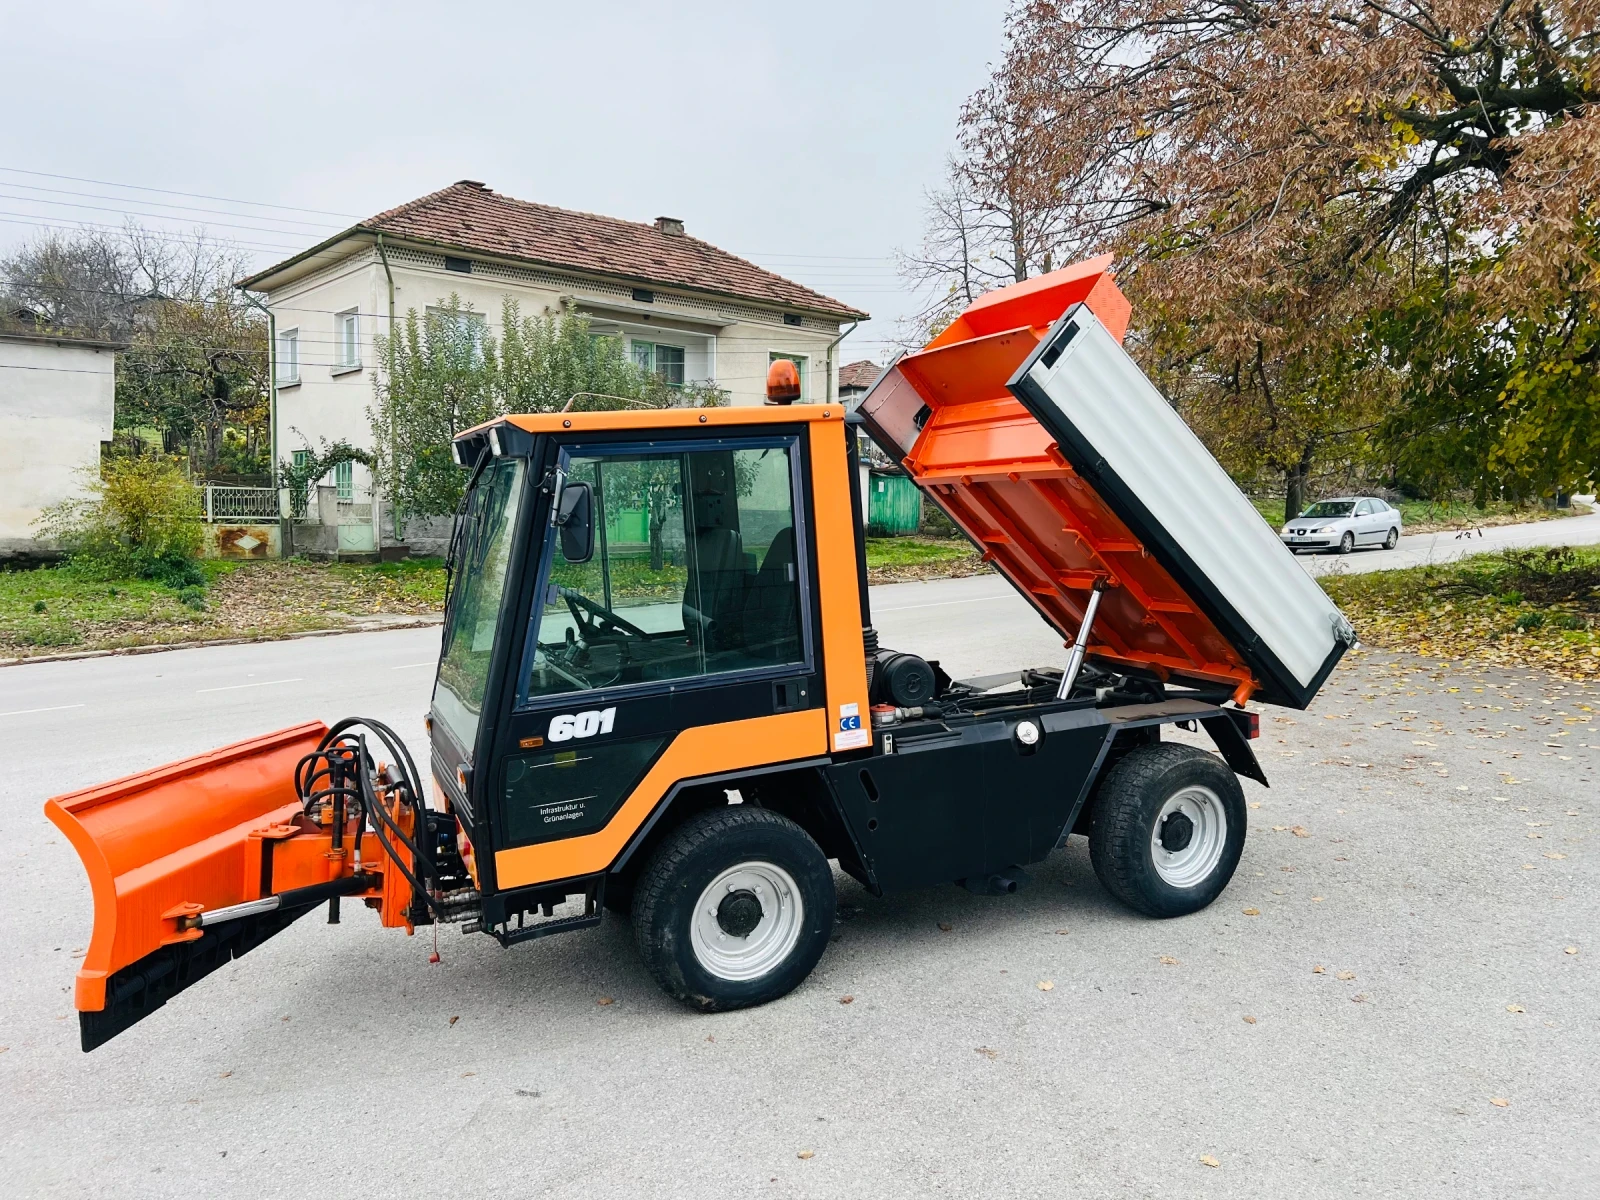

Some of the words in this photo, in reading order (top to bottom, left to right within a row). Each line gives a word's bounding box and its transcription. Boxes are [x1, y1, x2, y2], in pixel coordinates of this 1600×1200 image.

[548, 707, 616, 742] 601
[840, 716, 856, 730] CE
[540, 803, 578, 815] Infrastruktur
[543, 811, 584, 823] Grünanlagen
